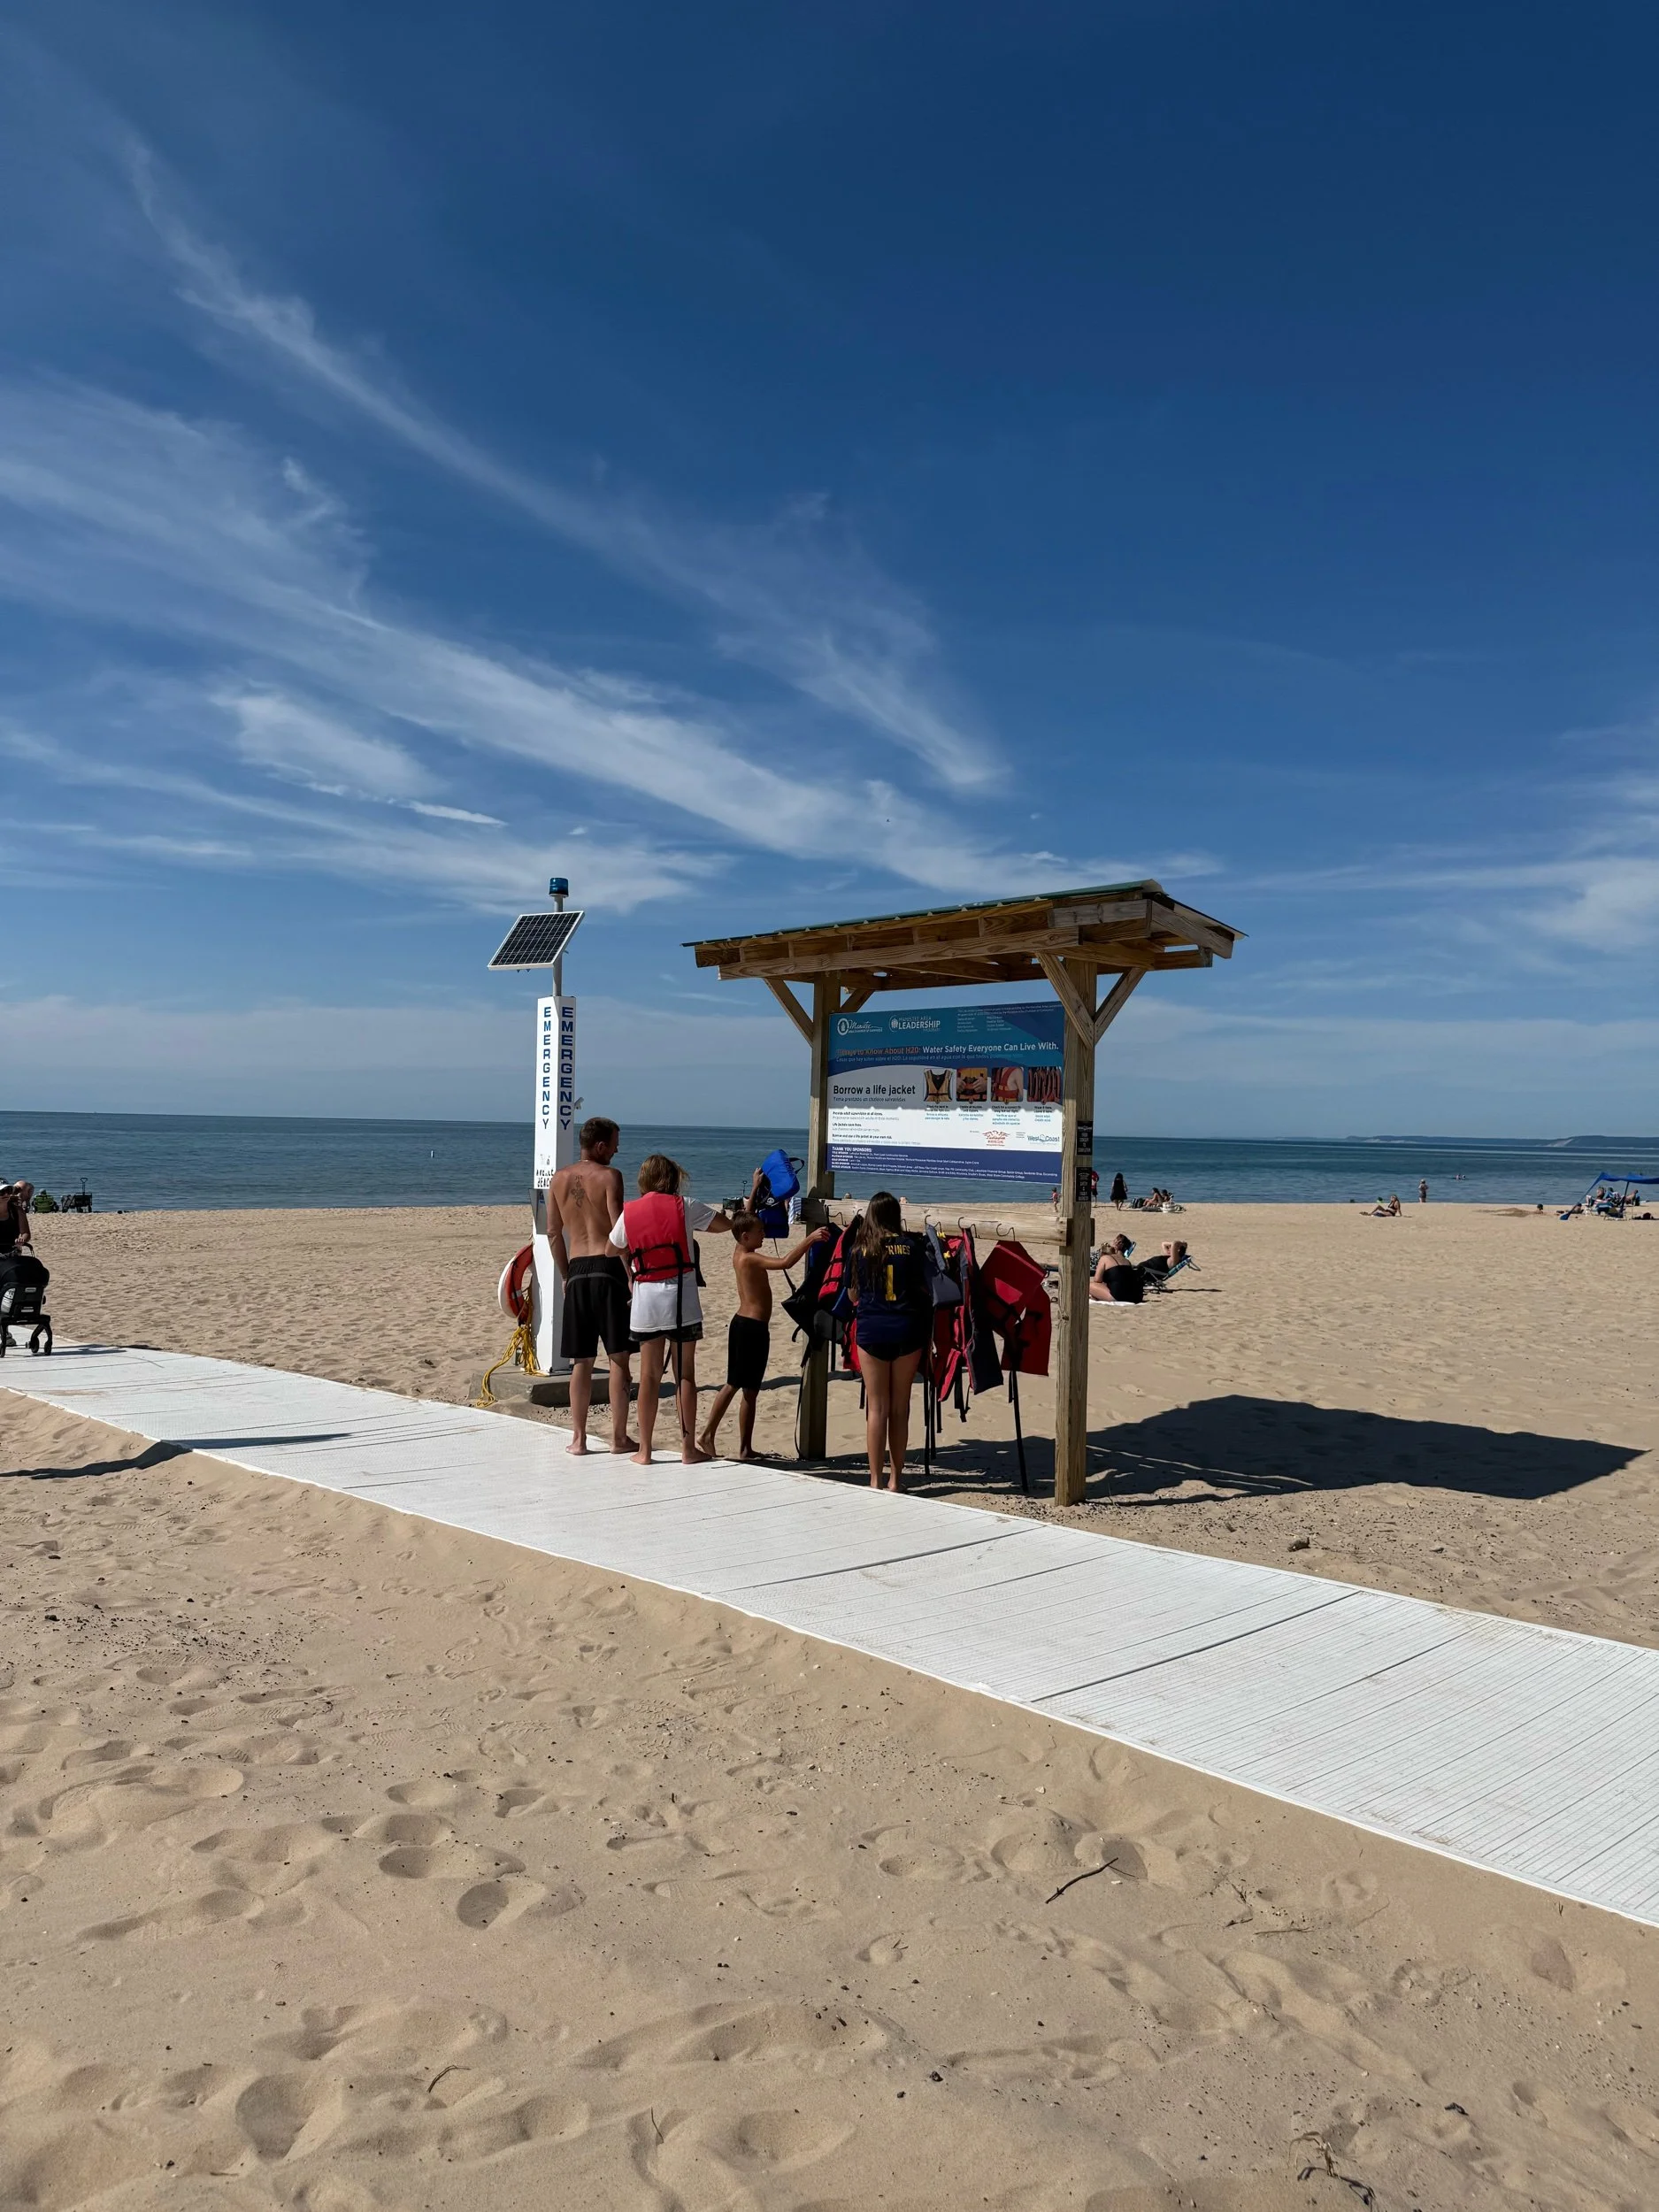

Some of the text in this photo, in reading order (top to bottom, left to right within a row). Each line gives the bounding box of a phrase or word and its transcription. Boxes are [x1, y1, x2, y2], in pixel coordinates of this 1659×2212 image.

[898, 1020, 941, 1030] LEADERSHIP
[944, 1045, 967, 1054] Safety
[968, 1044, 1002, 1053] Everyone
[1038, 1041, 1059, 1050] With.
[542, 1006, 551, 1130] EMERGENCY
[559, 1006, 574, 1131] EMERGENCY
[833, 1085, 864, 1094] Borrow
[873, 1085, 887, 1094] life
[888, 1085, 916, 1096] jacket
[885, 1264, 897, 1302] 1
